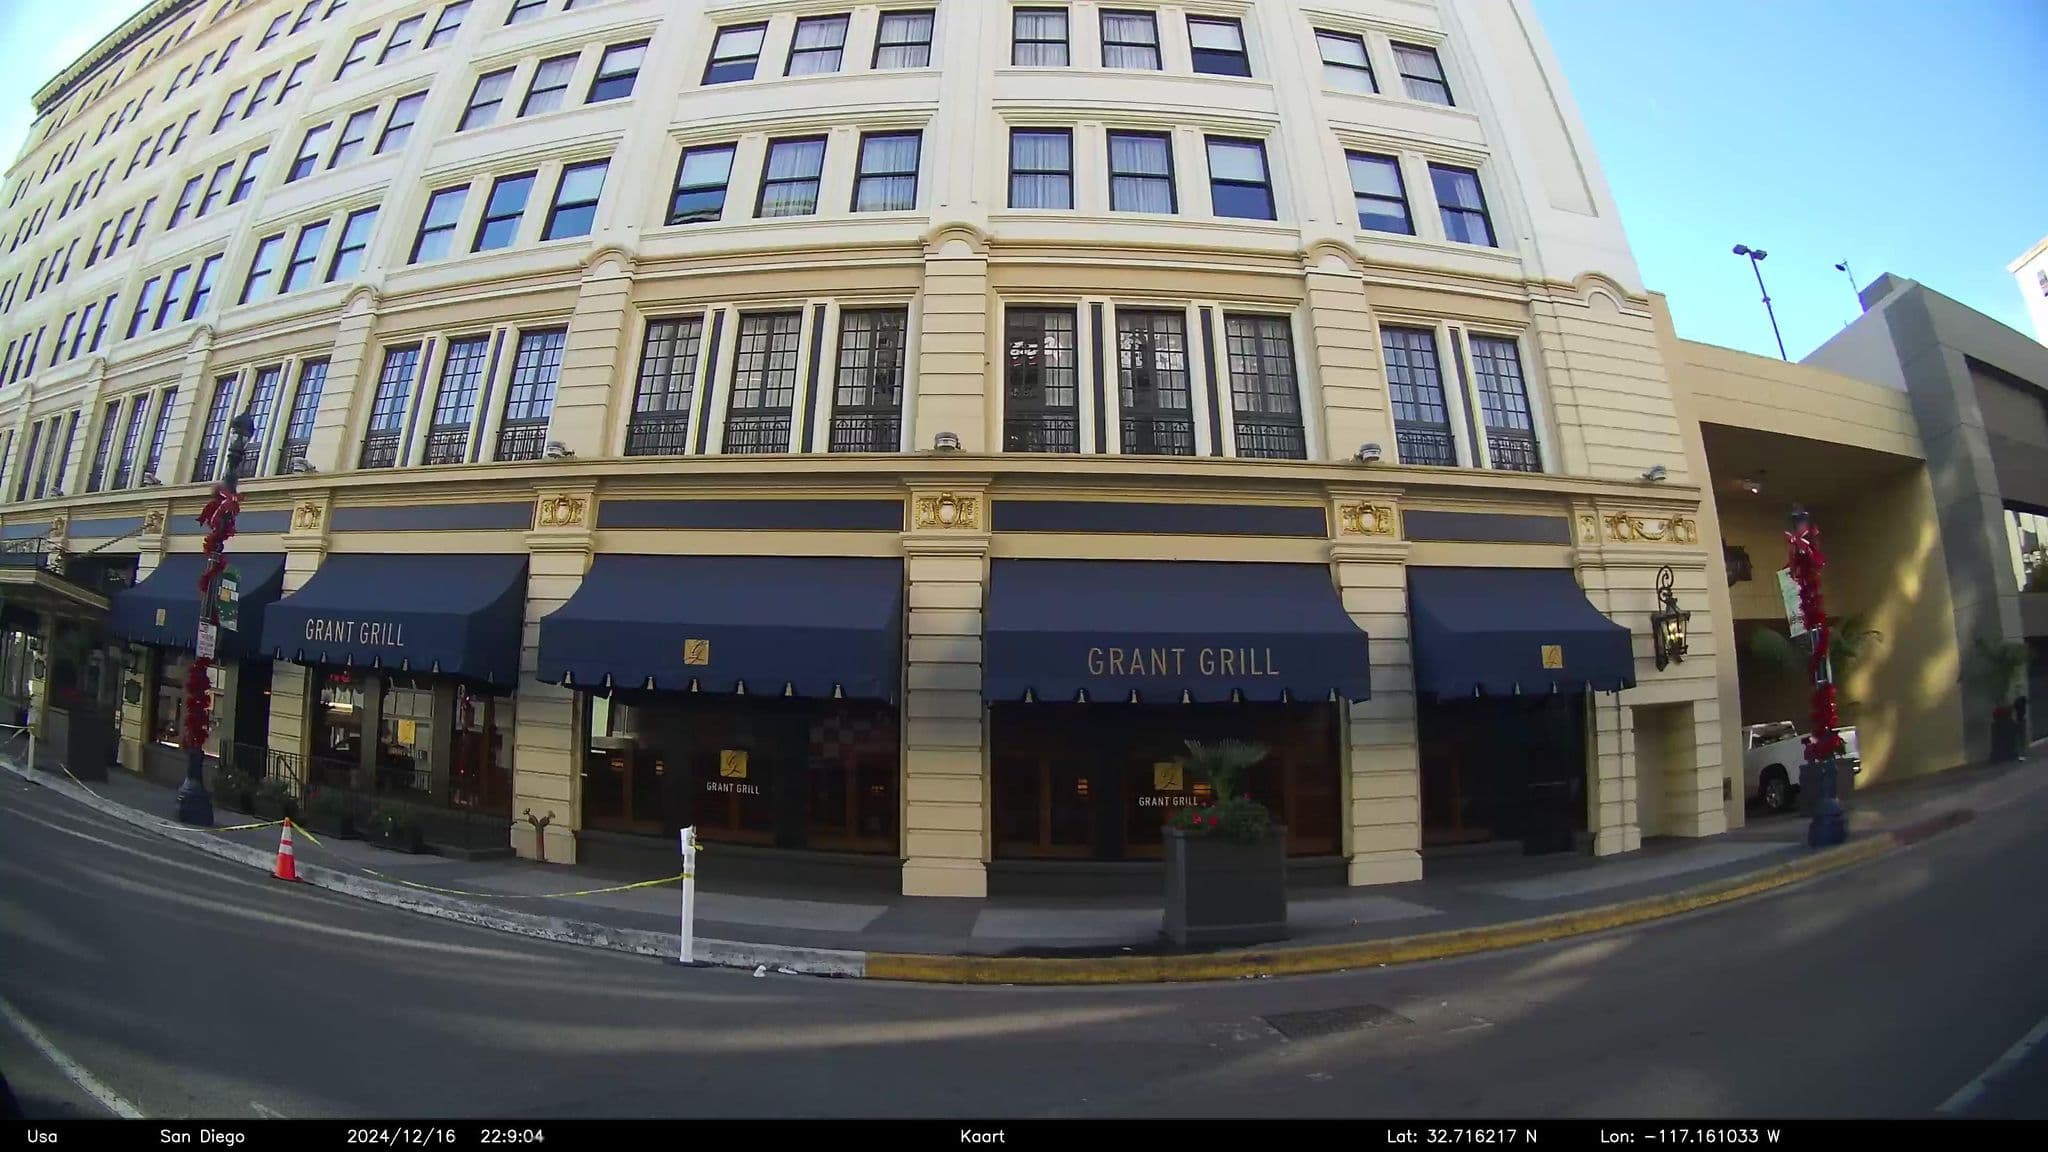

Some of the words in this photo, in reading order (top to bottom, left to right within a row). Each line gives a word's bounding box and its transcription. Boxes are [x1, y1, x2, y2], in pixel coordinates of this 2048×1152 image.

[304, 618, 355, 643] GRANT
[359, 622, 405, 647] GRILL
[1087, 647, 1186, 675] GRANT
[1199, 647, 1280, 676] GRILL
[706, 782, 734, 793] GRANT
[736, 784, 760, 795] GRILL
[1138, 796, 1170, 807] GRANT
[1172, 796, 1199, 807] GRILL
